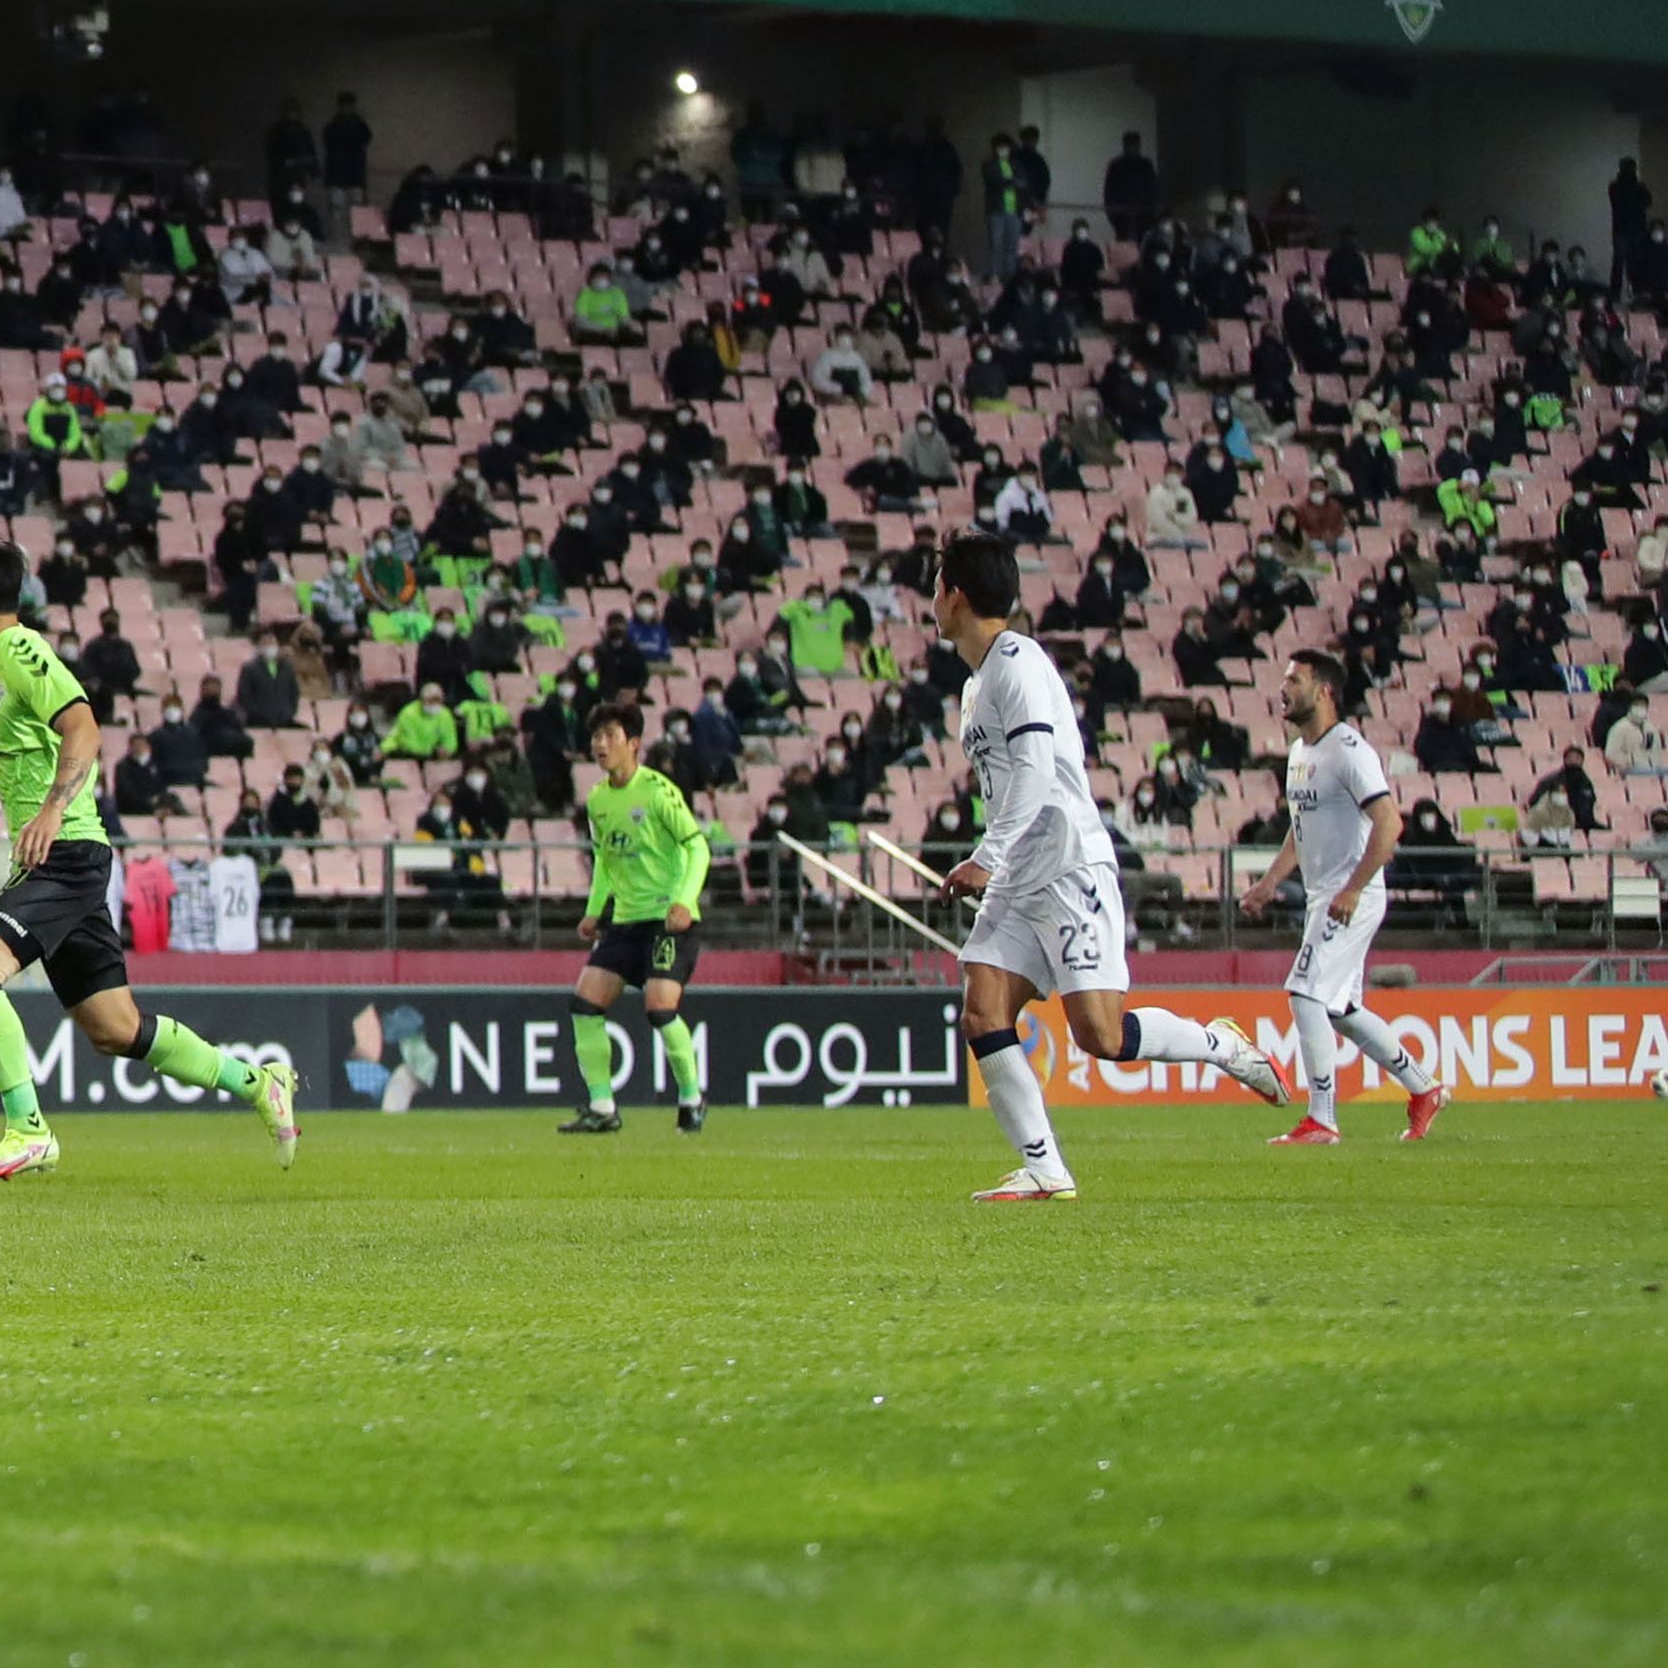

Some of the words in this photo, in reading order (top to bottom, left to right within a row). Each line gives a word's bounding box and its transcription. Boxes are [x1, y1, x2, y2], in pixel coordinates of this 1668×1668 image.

[222, 885, 249, 918] 26
[1059, 922, 1101, 965] 23
[747, 1004, 959, 1108] نيوم
